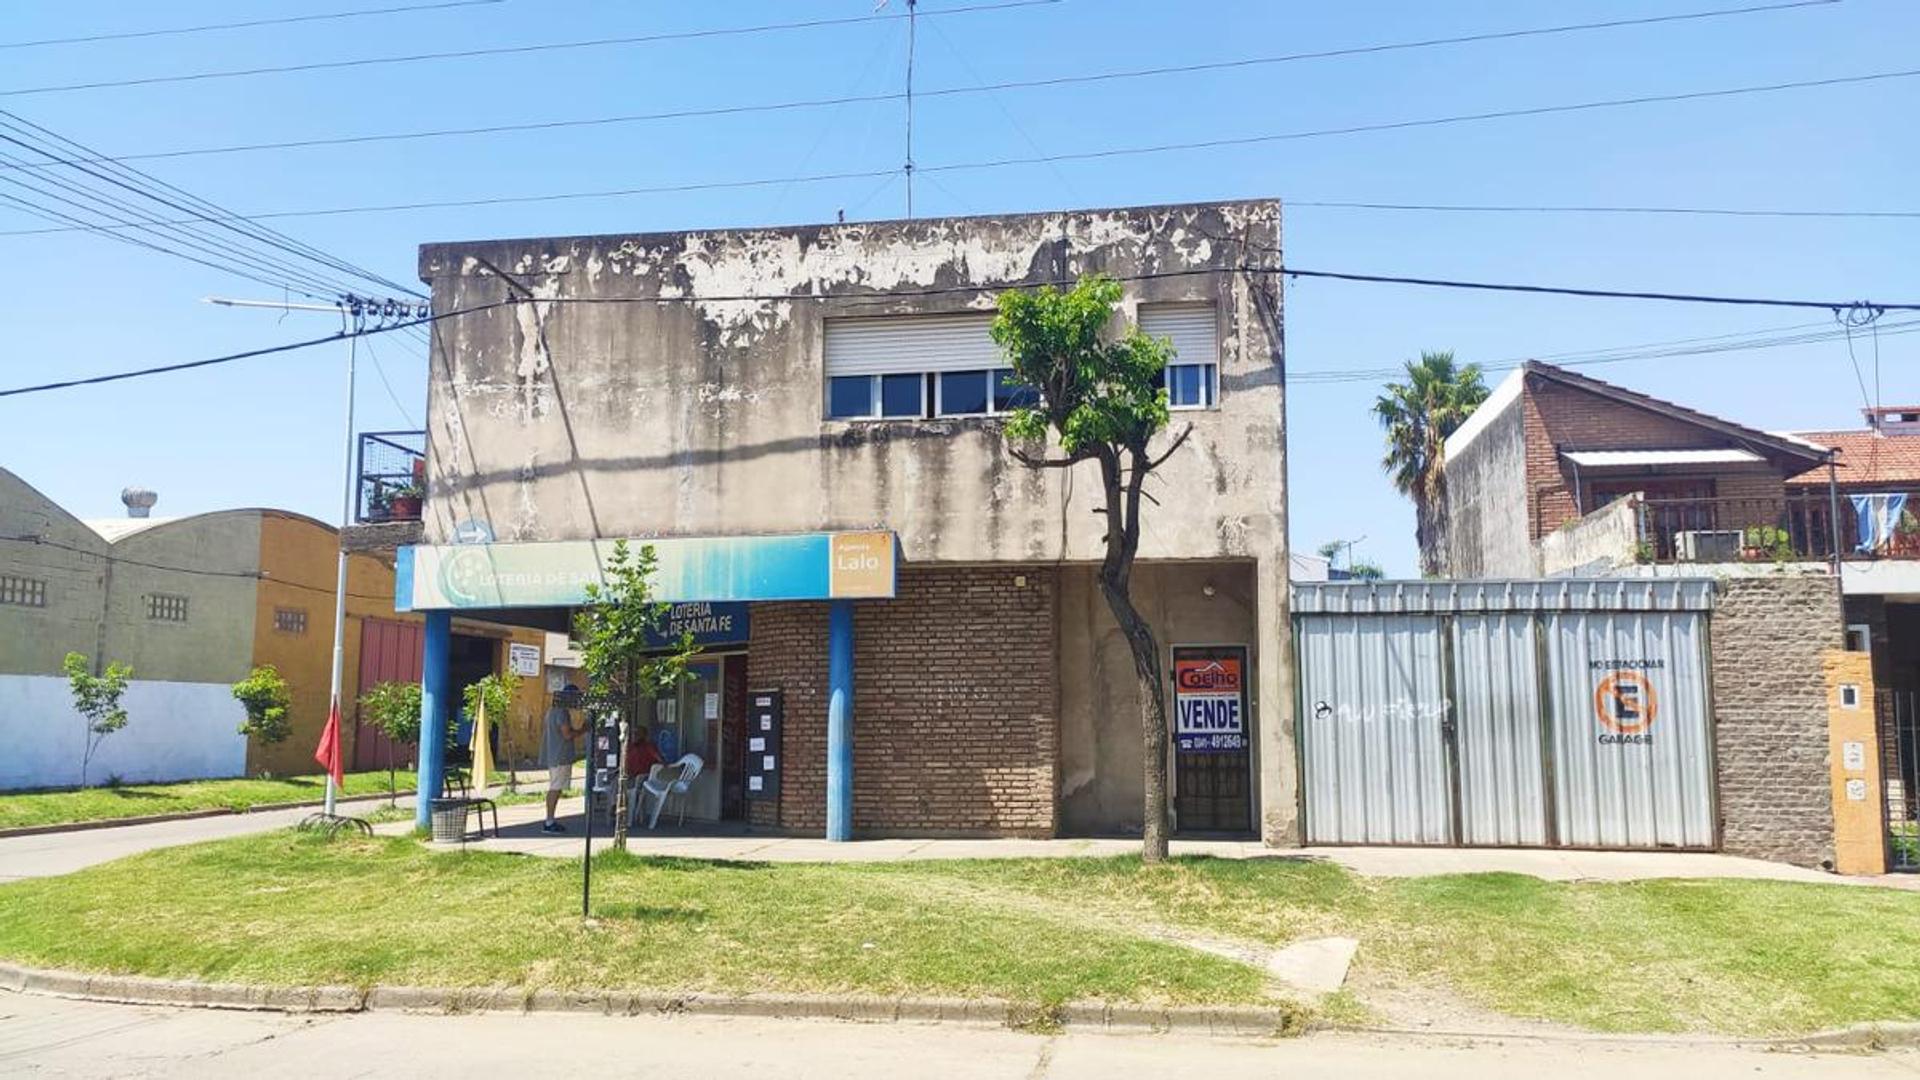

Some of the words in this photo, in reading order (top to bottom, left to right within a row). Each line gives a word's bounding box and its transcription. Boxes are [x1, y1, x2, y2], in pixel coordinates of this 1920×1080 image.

[838, 551, 880, 571] Lalo
[545, 571, 569, 585] DE
[670, 601, 712, 619] LOTERIA
[670, 620, 683, 636] DE
[684, 616, 718, 632] SANTA
[719, 615, 733, 631] FE
[1588, 660, 1604, 669] NO
[1179, 668, 1238, 688] Coelho
[1180, 699, 1240, 729] VENDE
[1598, 734, 1653, 745] GARAGE
